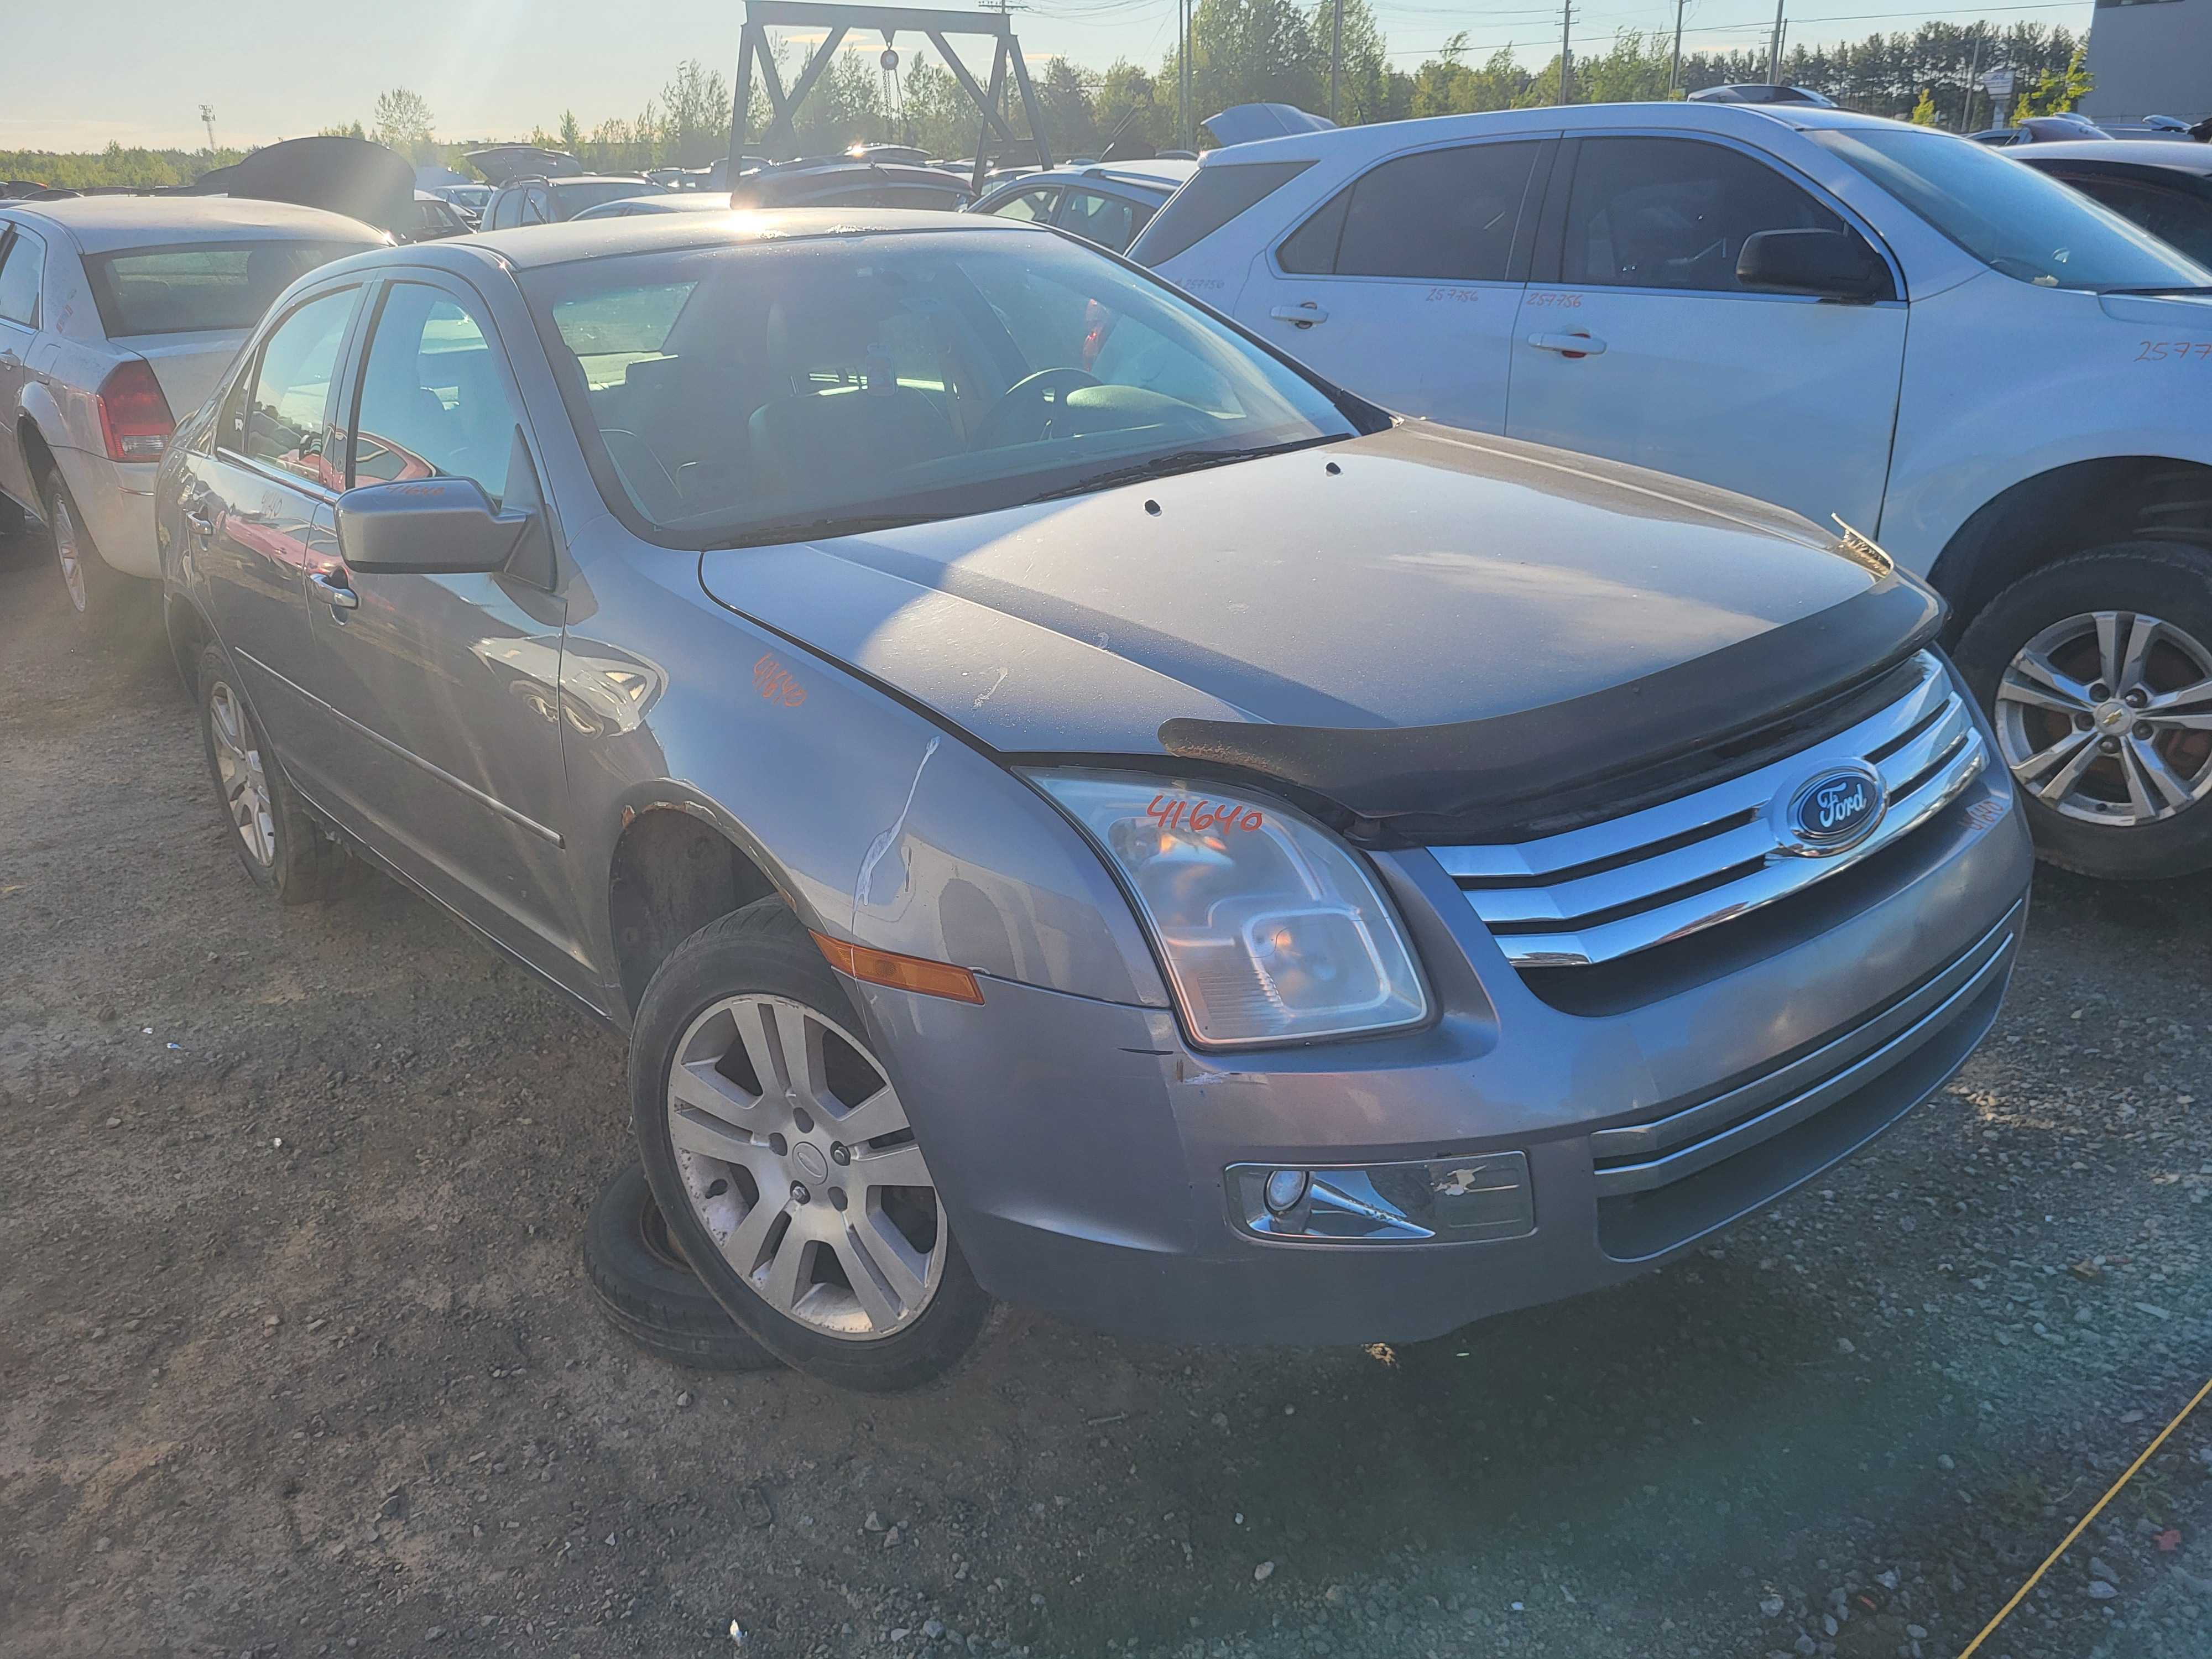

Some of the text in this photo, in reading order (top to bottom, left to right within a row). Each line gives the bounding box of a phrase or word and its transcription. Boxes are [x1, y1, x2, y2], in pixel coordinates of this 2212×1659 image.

[1526, 292, 1584, 308] 257756
[1146, 795, 1262, 836] 41640
[1816, 781, 1867, 828] Ford
